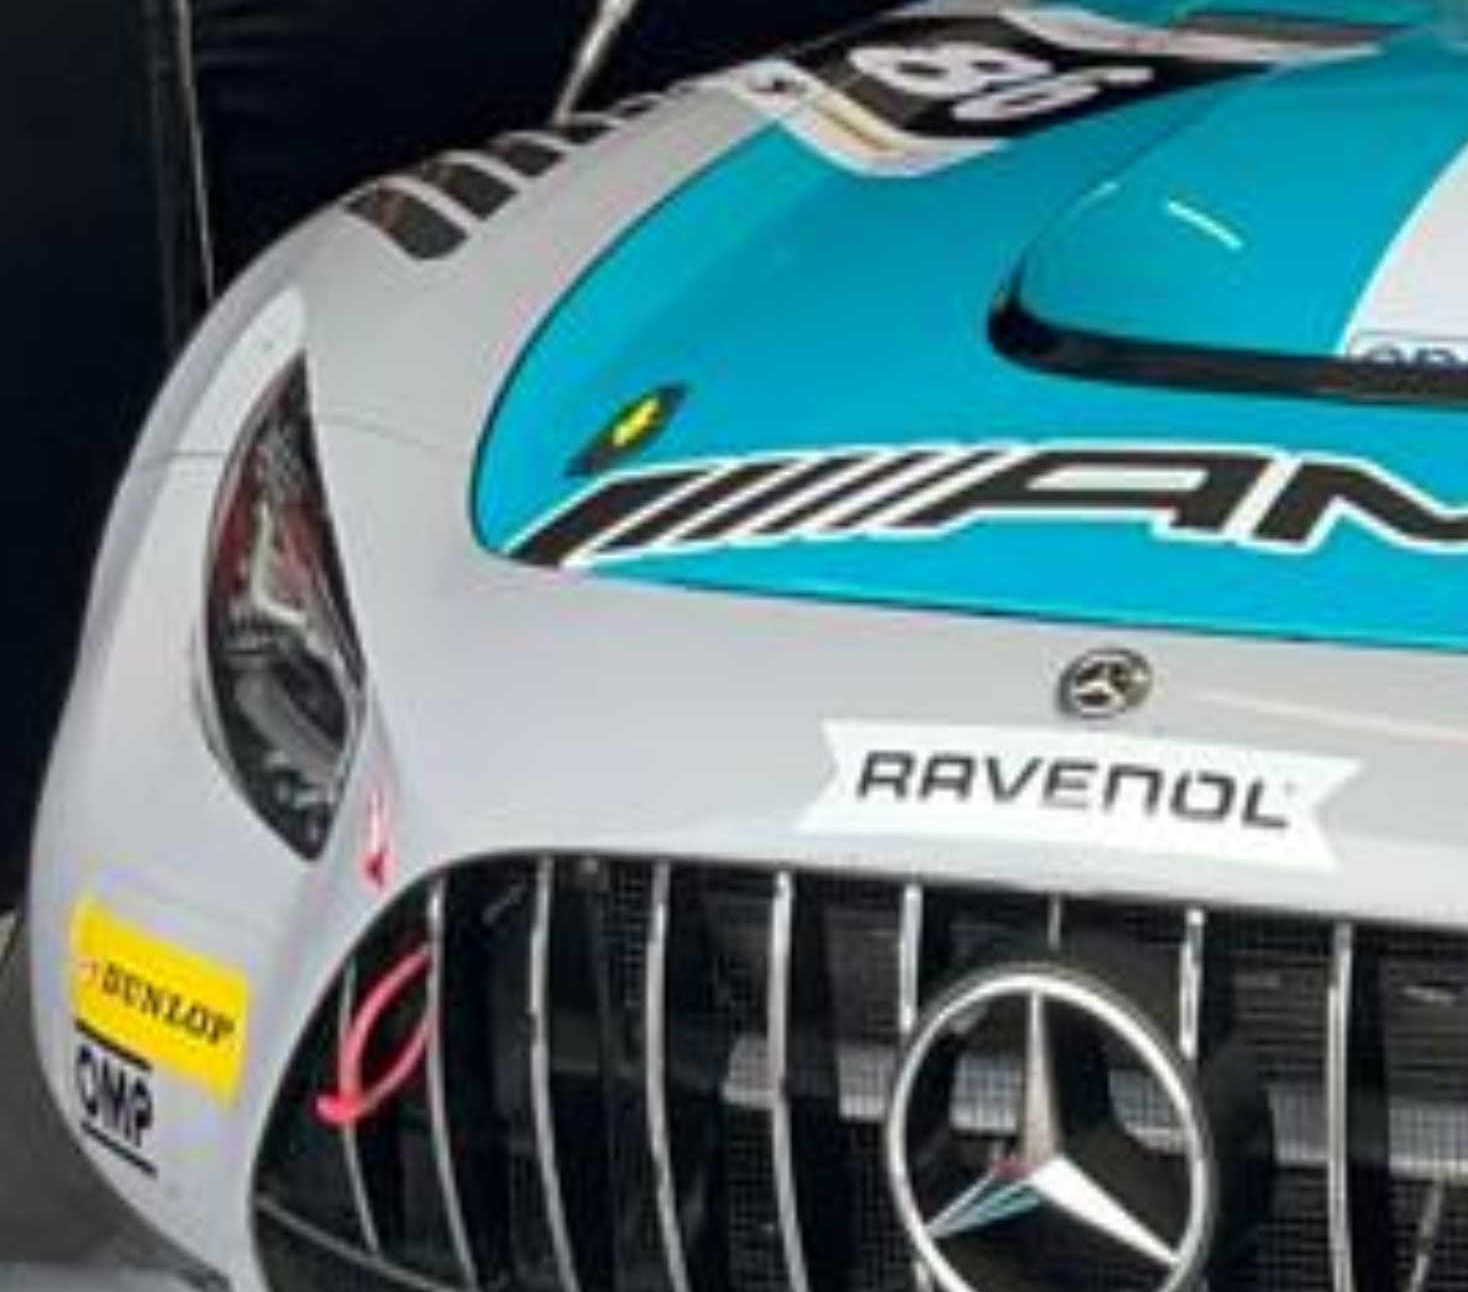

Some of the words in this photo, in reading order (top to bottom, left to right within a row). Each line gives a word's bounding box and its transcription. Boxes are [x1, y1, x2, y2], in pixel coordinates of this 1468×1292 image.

[855, 749, 1291, 830] RAVENOL
[102, 960, 235, 1046] DUNLOP
[76, 1043, 152, 1147] OMP
